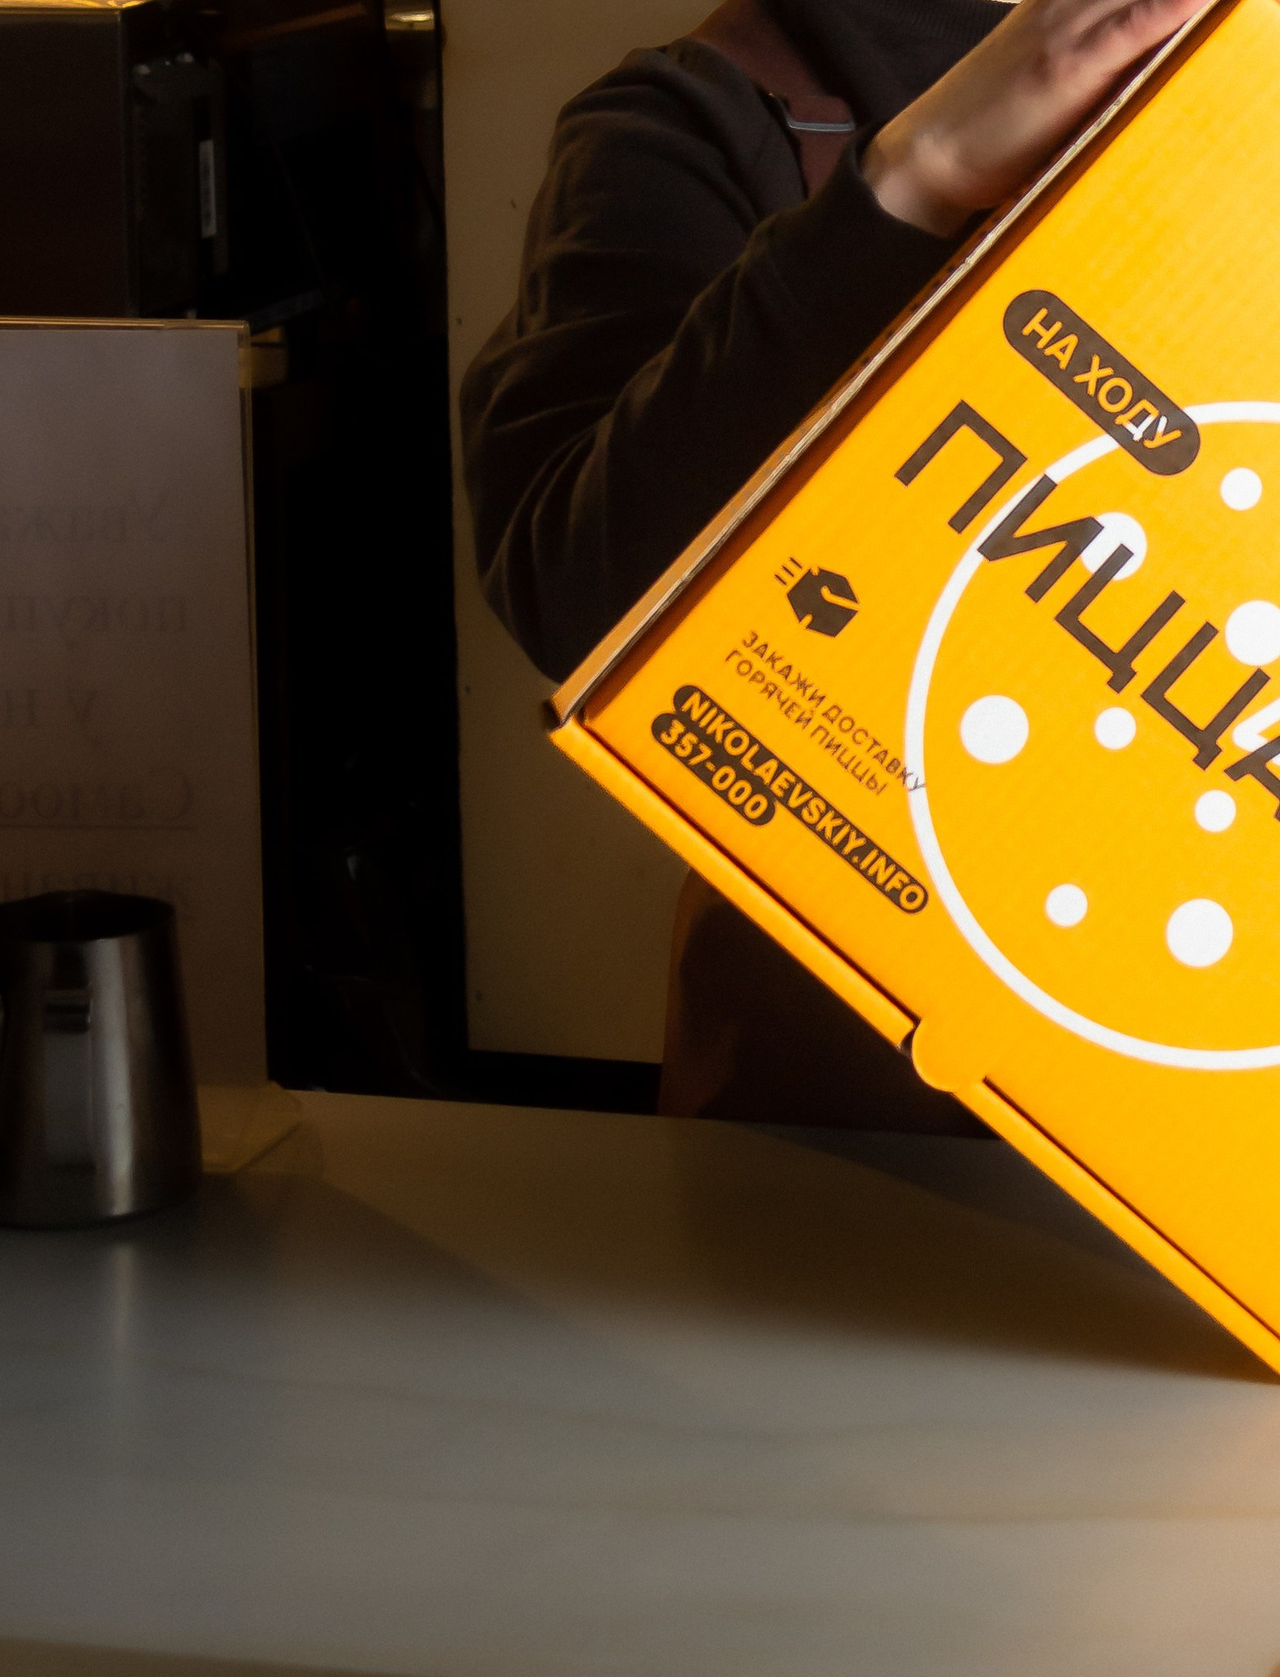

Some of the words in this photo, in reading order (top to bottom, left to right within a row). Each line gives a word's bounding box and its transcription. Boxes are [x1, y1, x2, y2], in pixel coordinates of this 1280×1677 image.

[1020, 308, 1080, 371] НА
[1074, 355, 1183, 450] ХОДУ
[659, 721, 768, 821] 357-000
[724, 649, 812, 731] ГОРЯЧЕЙ
[810, 724, 890, 796] ПИЦЦЫ
[741, 630, 827, 708] ЗАКАЖИ
[821, 703, 926, 793] ДОСТАВКУ
[682, 691, 926, 911] NIKOLAEVSKIY.INFO
